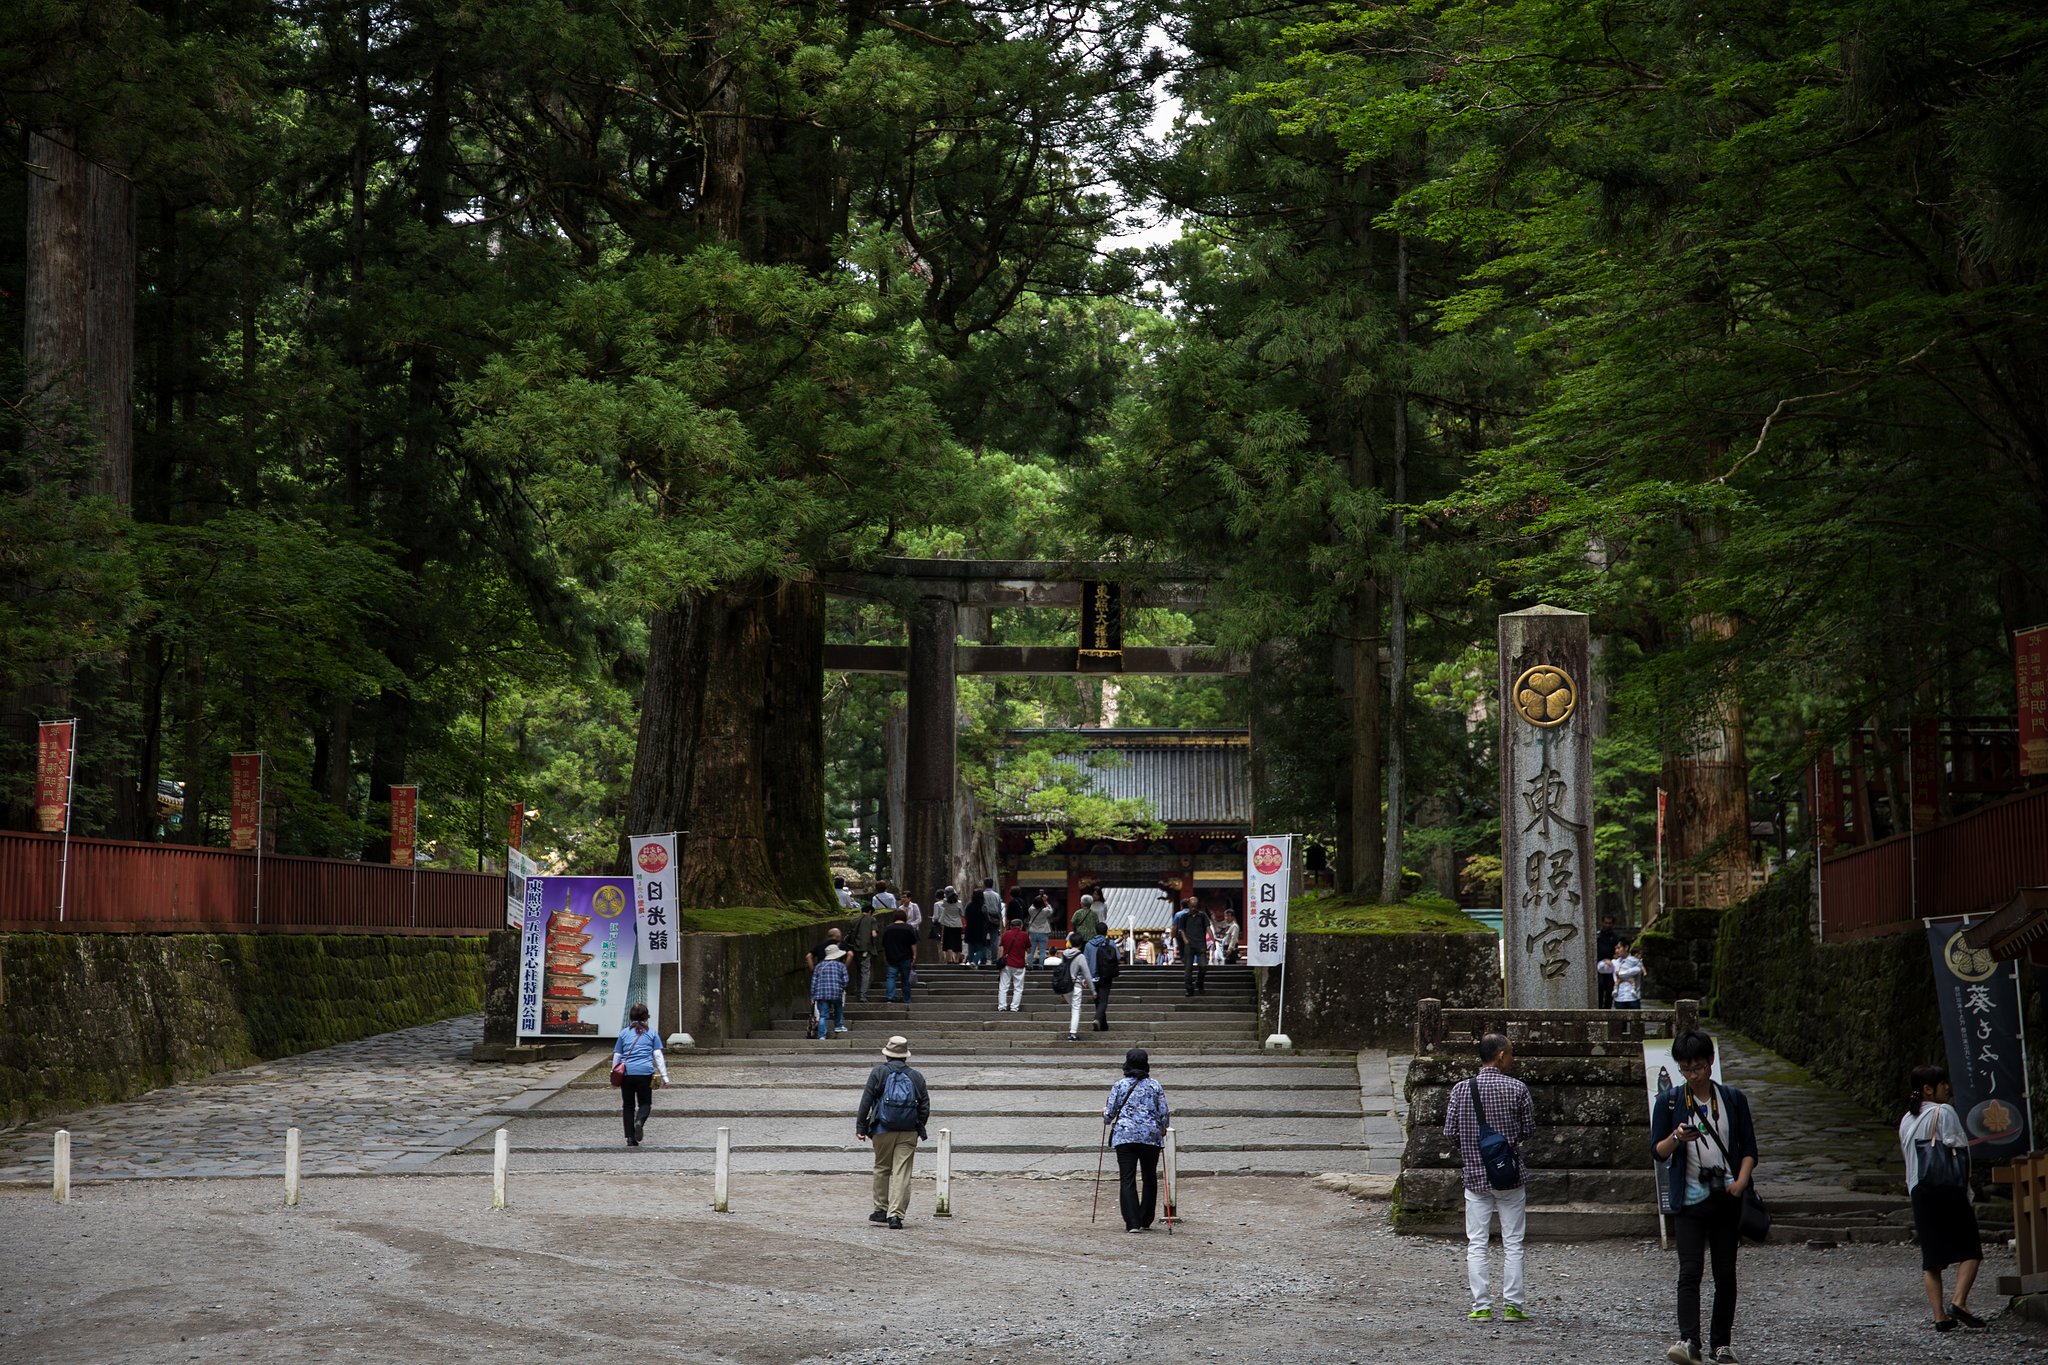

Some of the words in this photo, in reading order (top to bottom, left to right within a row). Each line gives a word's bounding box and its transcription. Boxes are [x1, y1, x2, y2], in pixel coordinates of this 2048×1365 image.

[527, 879, 544, 918] 東照宮
[1521, 763, 1588, 981] 東照宮
[521, 920, 541, 1032] 五重塔心柱特別公開
